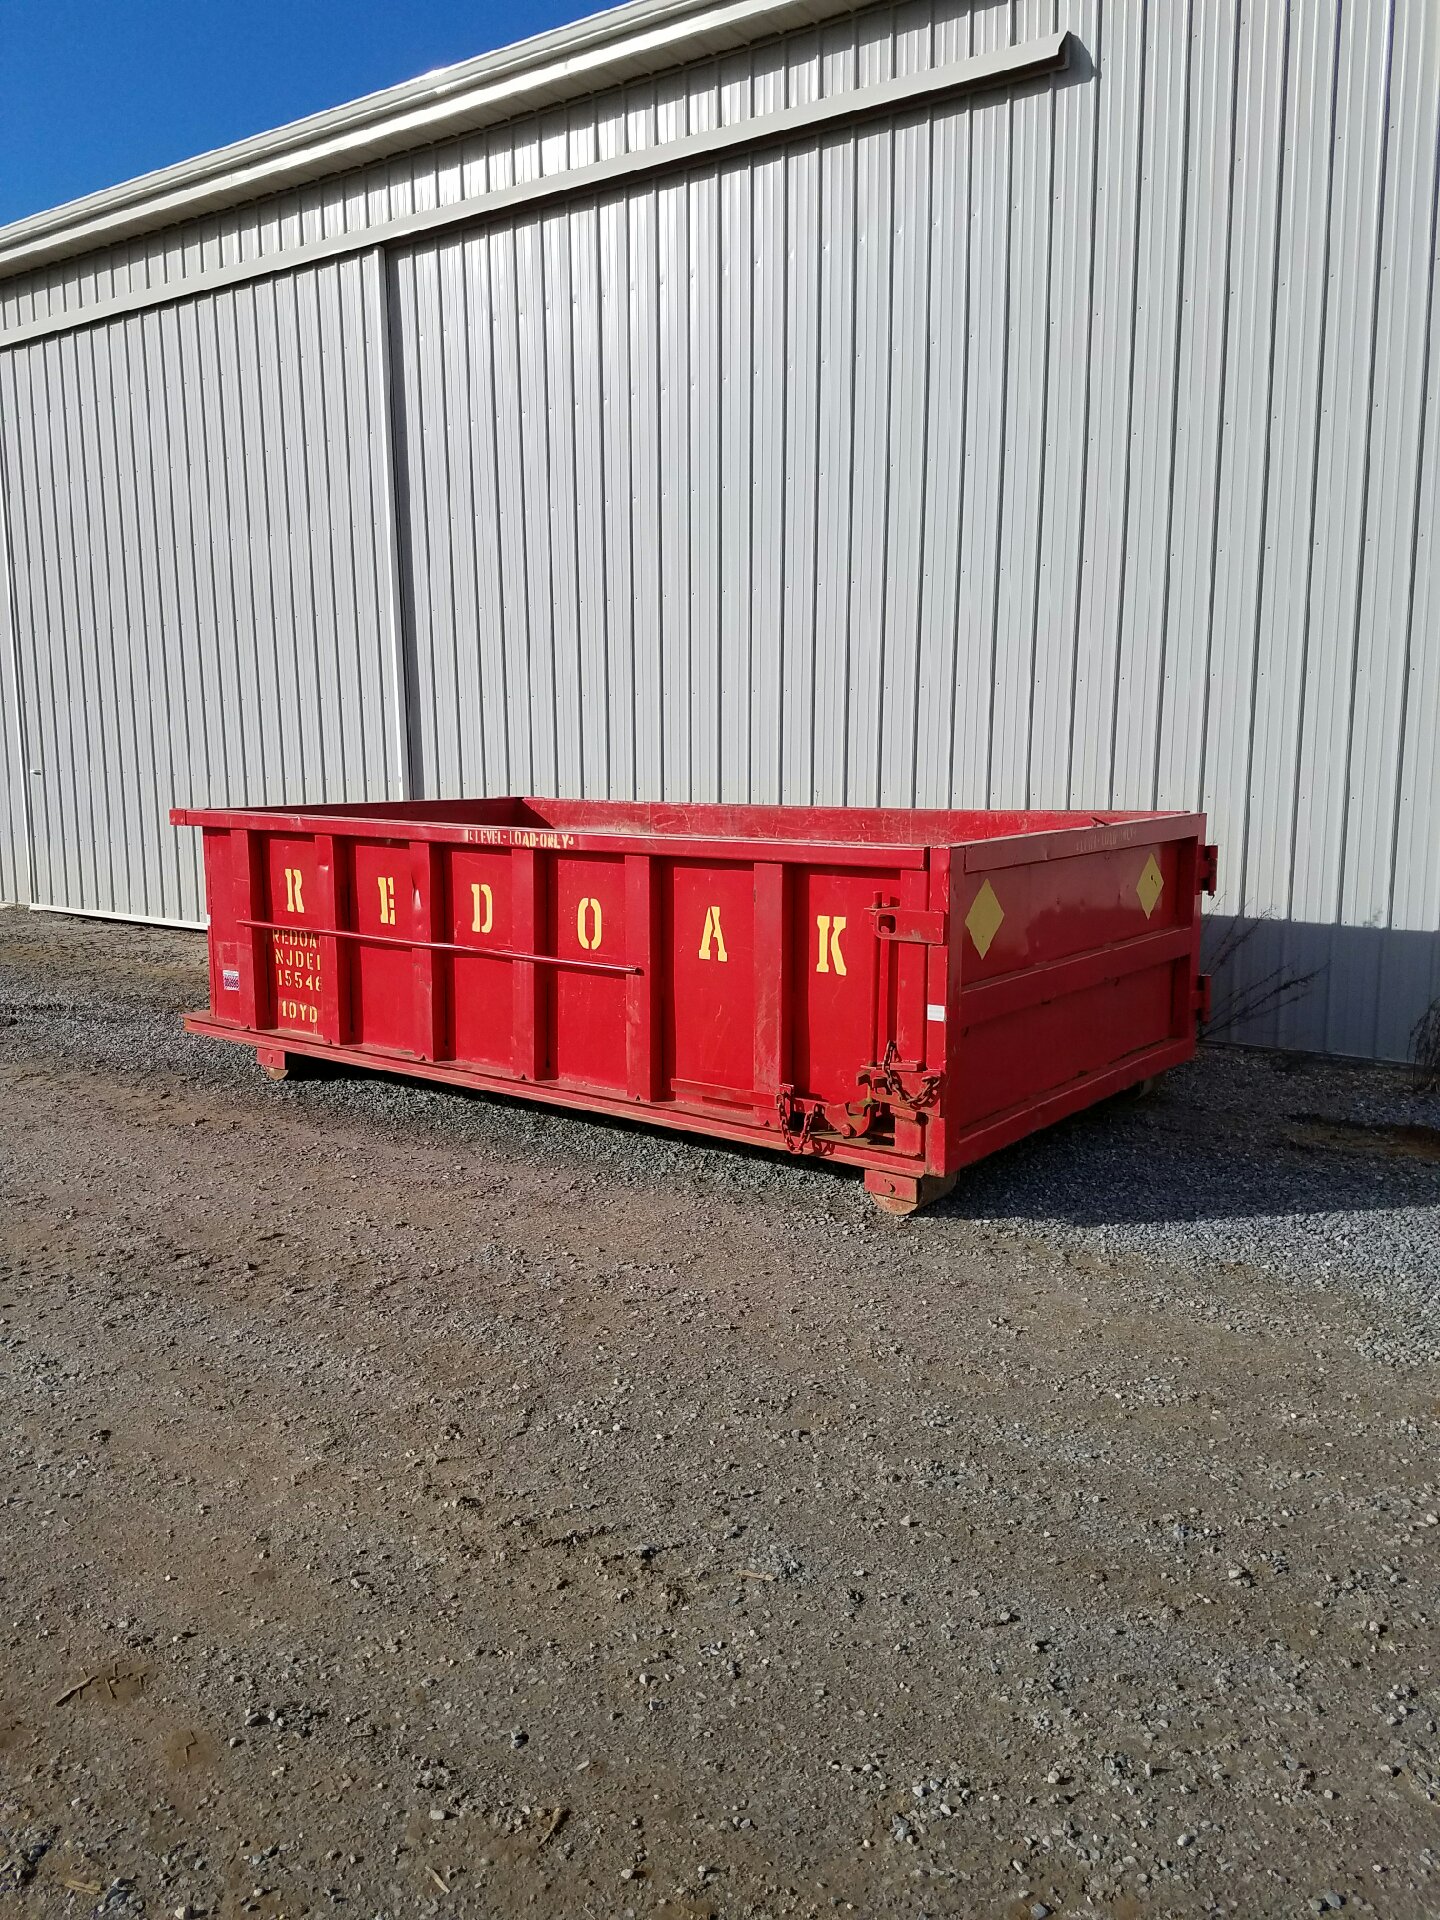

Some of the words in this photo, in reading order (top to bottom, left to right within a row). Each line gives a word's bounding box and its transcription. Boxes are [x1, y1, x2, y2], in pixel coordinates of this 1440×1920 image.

[272, 929, 321, 949] REDOA
[285, 868, 305, 914] R
[377, 876, 396, 926] E
[471, 883, 493, 933] D
[698, 906, 728, 962] A
[816, 914, 847, 976] K
